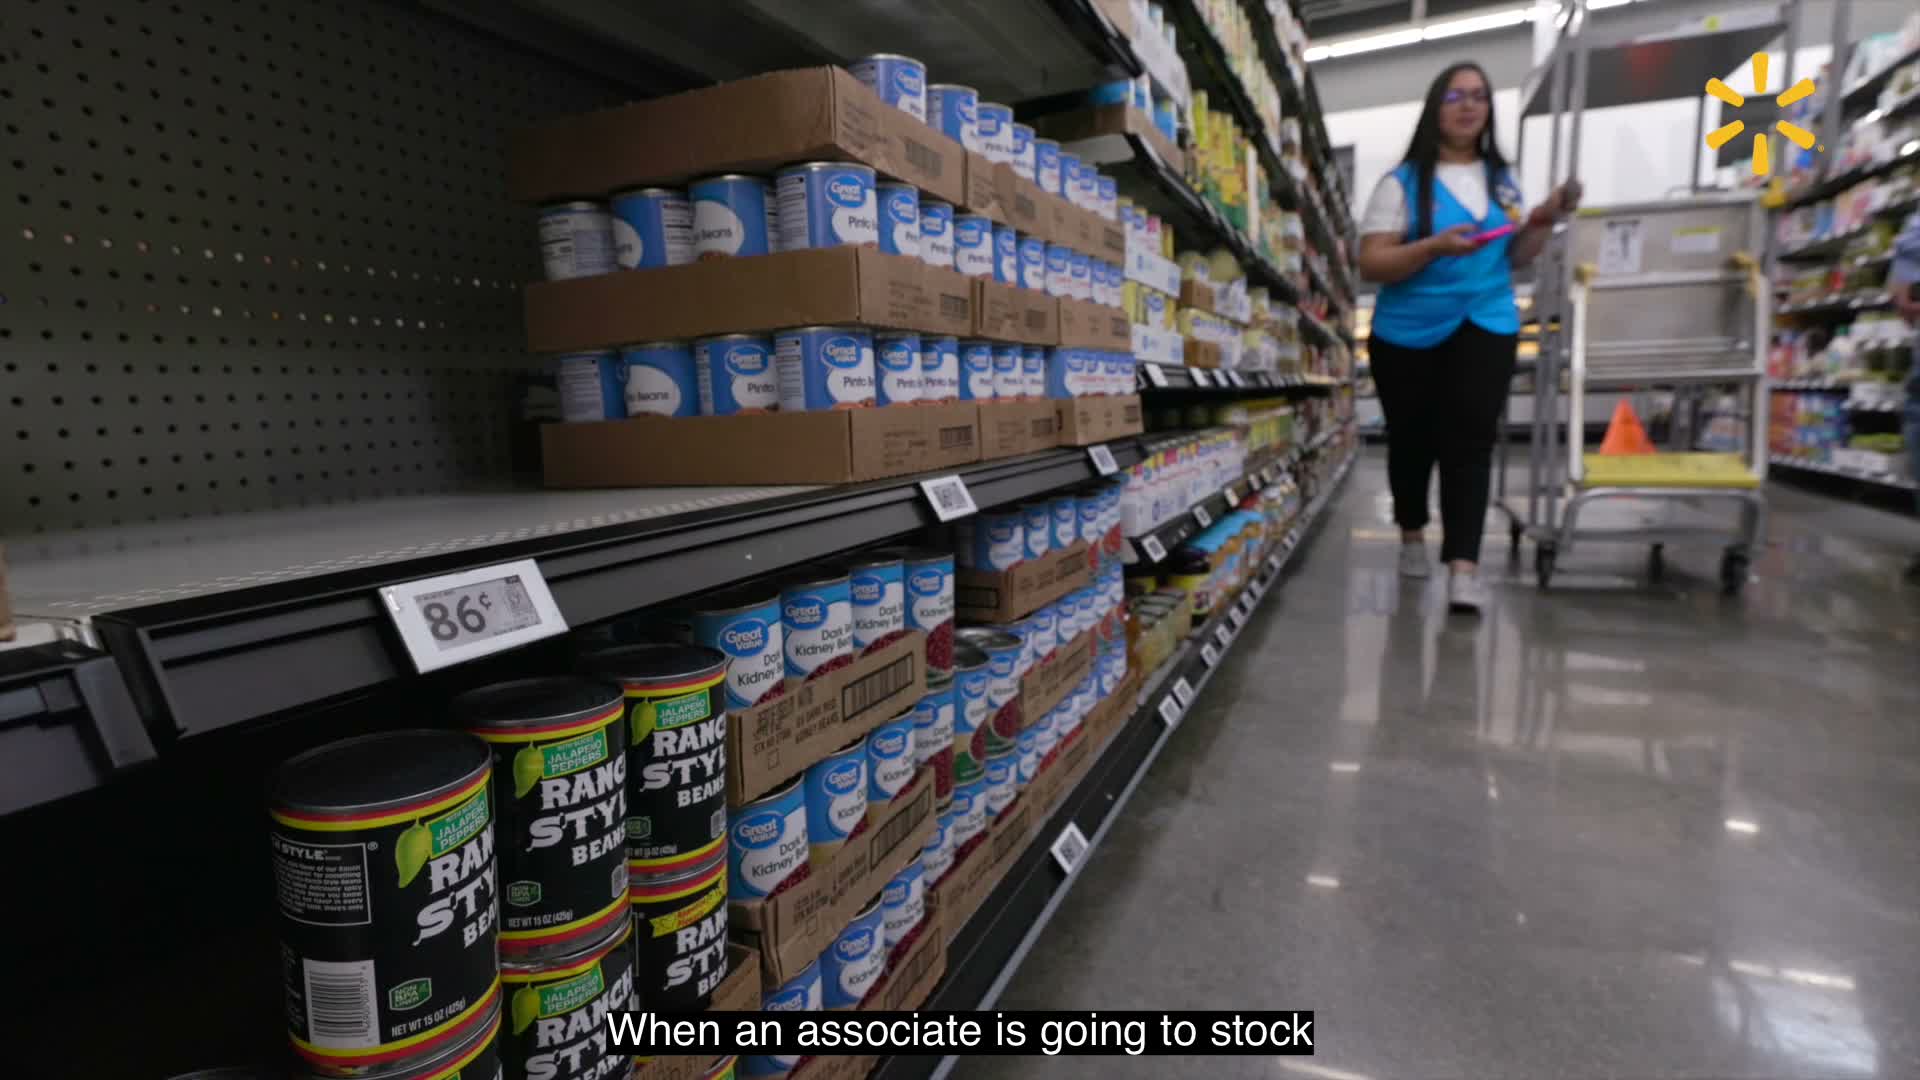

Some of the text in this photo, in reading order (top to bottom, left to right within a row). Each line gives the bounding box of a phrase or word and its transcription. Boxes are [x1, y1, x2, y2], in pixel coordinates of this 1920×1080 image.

[747, 382, 777, 394] Pinto
[785, 603, 820, 617] Great
[725, 626, 763, 643] Great
[735, 638, 763, 651] Value
[795, 643, 835, 657] Kidney
[737, 668, 776, 688] Kidney
[739, 817, 777, 838] Great
[280, 843, 325, 861] STYLE
[751, 855, 793, 880] Kidney
[391, 1023, 407, 1038] NET
[408, 1018, 422, 1032] WT
[423, 1014, 433, 1027] 15
[434, 1010, 444, 1023] OZ
